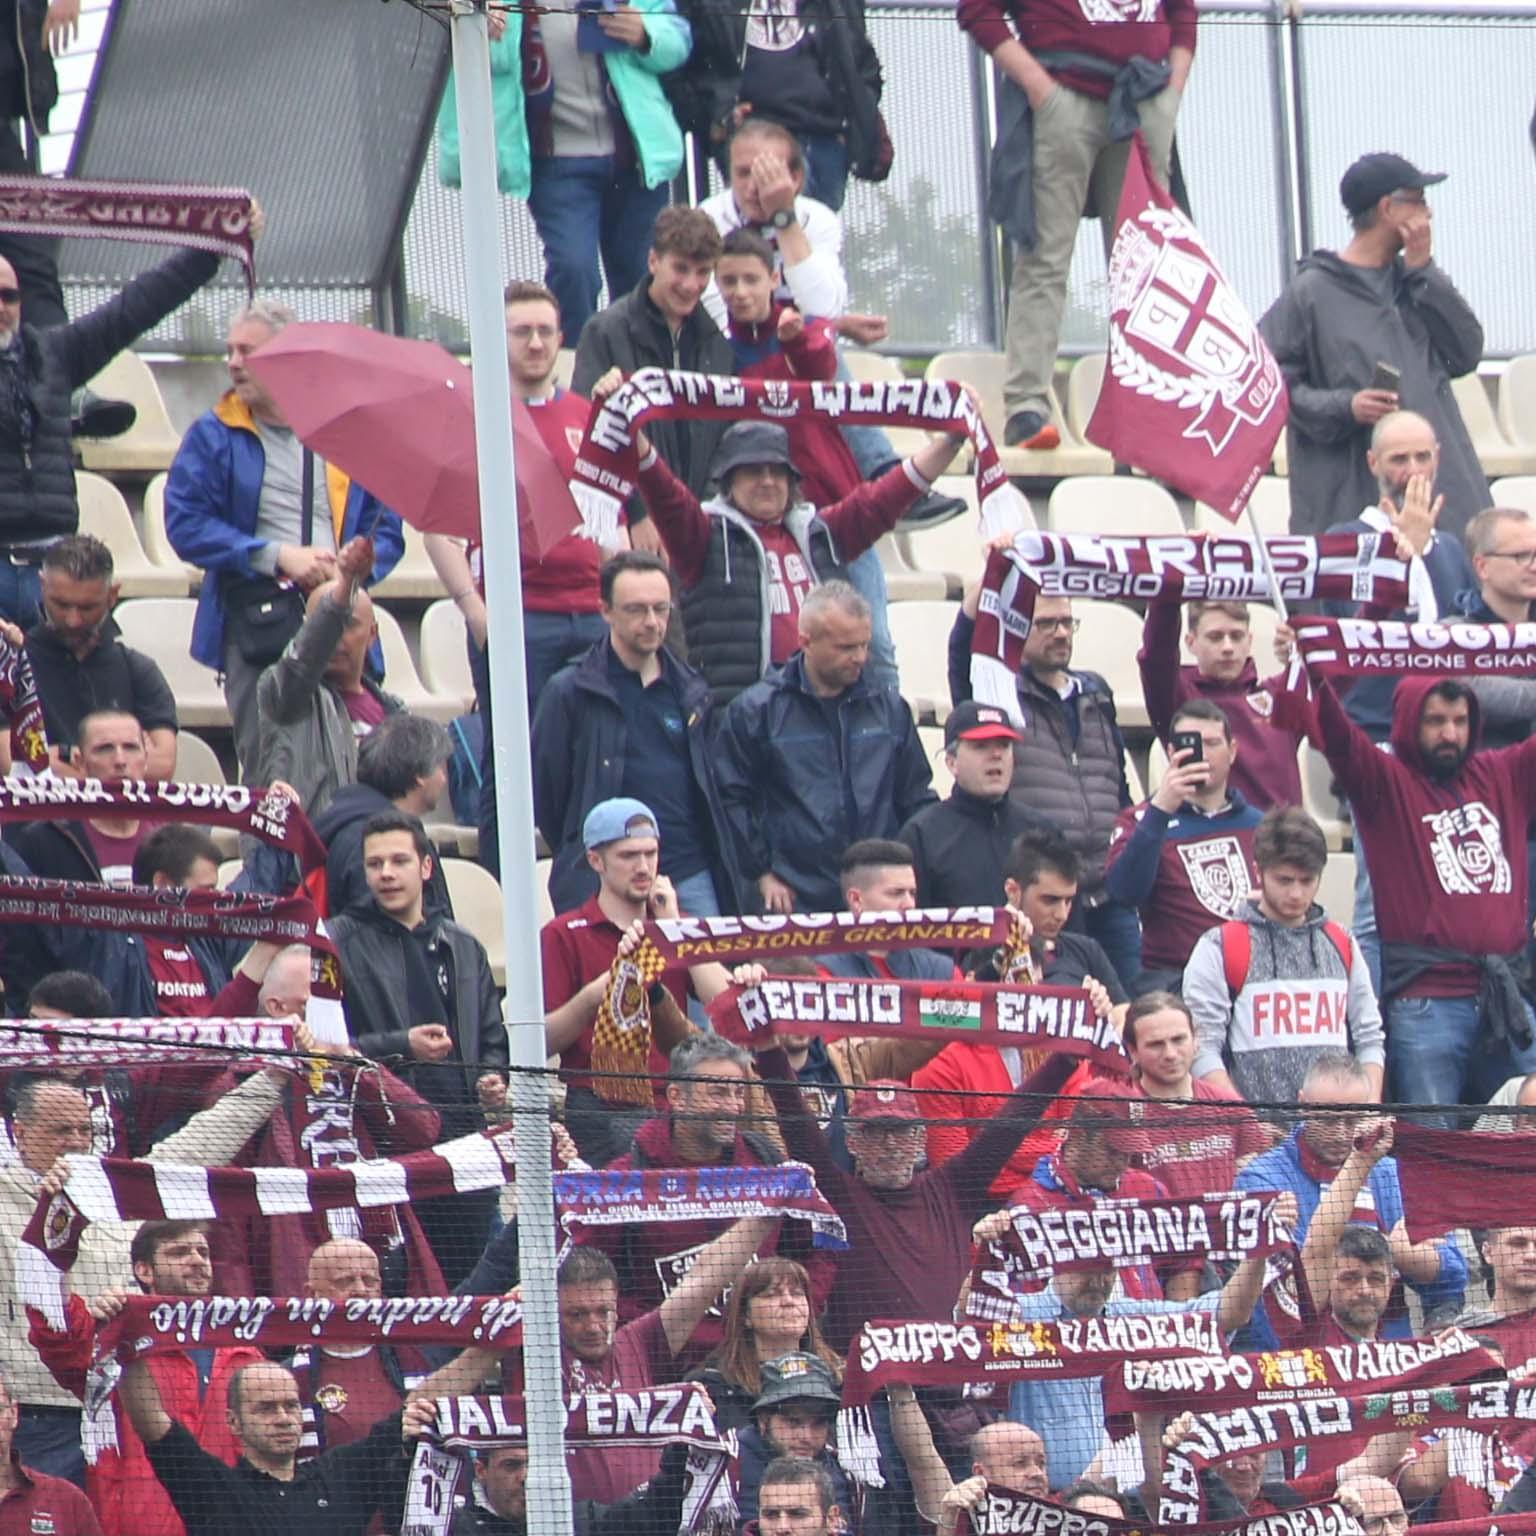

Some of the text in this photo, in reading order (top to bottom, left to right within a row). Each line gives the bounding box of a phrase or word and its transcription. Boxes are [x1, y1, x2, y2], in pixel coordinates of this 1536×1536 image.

[1038, 570, 1162, 598] EGGIO
[1349, 652, 1468, 670] PASSIONE
[676, 923, 993, 961] PASSIONE GRANATA
[735, 980, 1128, 1057] REGGIO EMILIA
[1027, 1196, 1211, 1271] REGGIANA
[860, 1311, 1223, 1374] GRUPPO VANDELLI
[1123, 1355, 1254, 1395] GRUPPO
